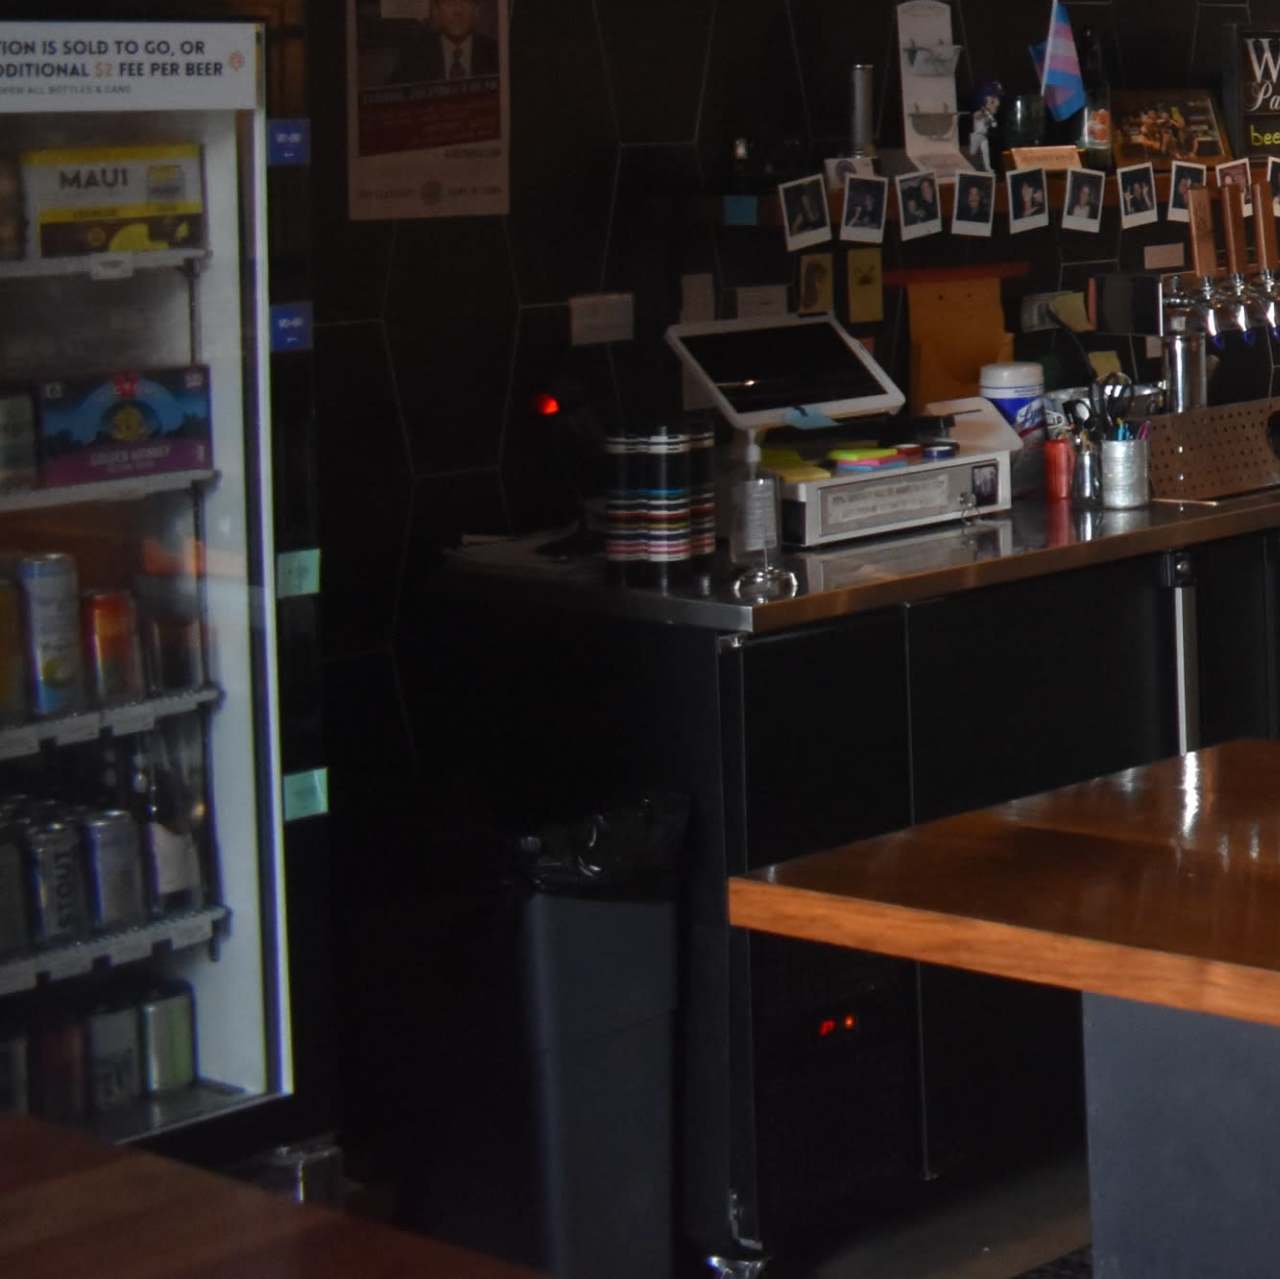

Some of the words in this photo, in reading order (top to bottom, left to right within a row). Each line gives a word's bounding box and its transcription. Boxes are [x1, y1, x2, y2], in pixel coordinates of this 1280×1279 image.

[0, 40, 36, 55] ION
[42, 40, 57, 55] IS
[63, 40, 109, 55] SOLD
[114, 40, 138, 55] TO
[144, 40, 175, 57] GO,
[180, 40, 206, 55] OR
[119, 62, 145, 77] FEE
[150, 62, 180, 77] PER
[185, 62, 223, 76] BEER
[59, 167, 129, 189] MAUI
